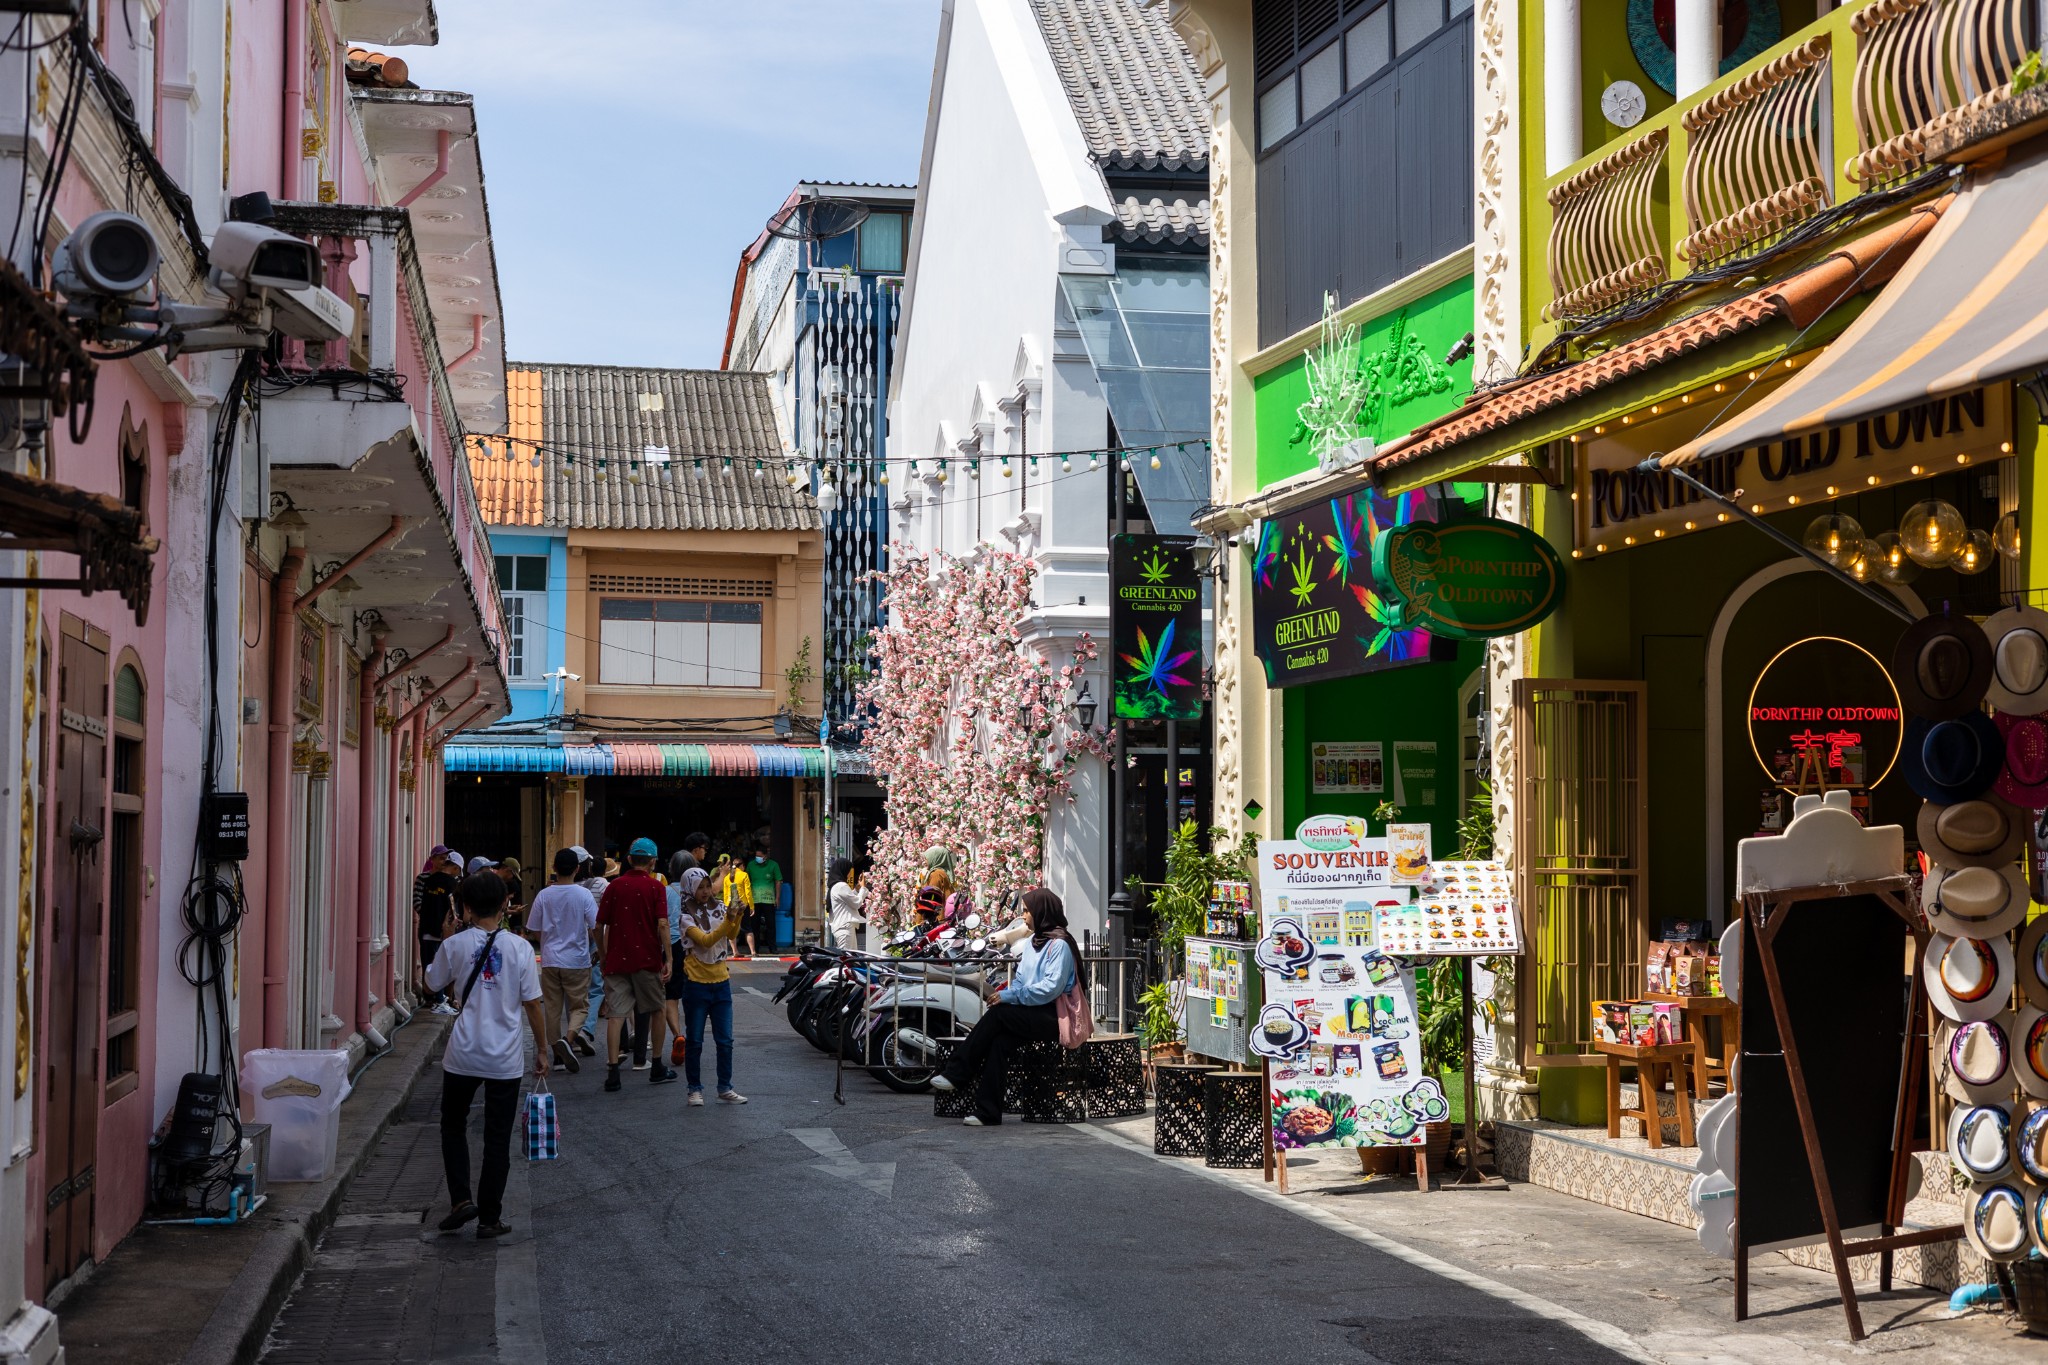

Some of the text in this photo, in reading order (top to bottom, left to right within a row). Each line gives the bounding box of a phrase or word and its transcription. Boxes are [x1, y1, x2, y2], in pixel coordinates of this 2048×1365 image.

[1447, 555, 1542, 577] PORNTHIP
[1119, 586, 1197, 600] GREENLAND
[1438, 583, 1533, 605] OLDTOWN
[1131, 602, 1182, 612] Cannabis 420
[1275, 610, 1340, 646] GREENLAND
[1286, 647, 1329, 670] Cannabis 420
[1751, 707, 1899, 721] PORNTHIP OLDTOWN
[1304, 825, 1342, 837] พรทิพย์
[1311, 836, 1341, 844] Pornthip
[1273, 850, 1389, 870] SOUVENIR
[1287, 869, 1382, 885] ที่นี่มีของฝากภูเก็ต
[1337, 1030, 1371, 1041] Mango
